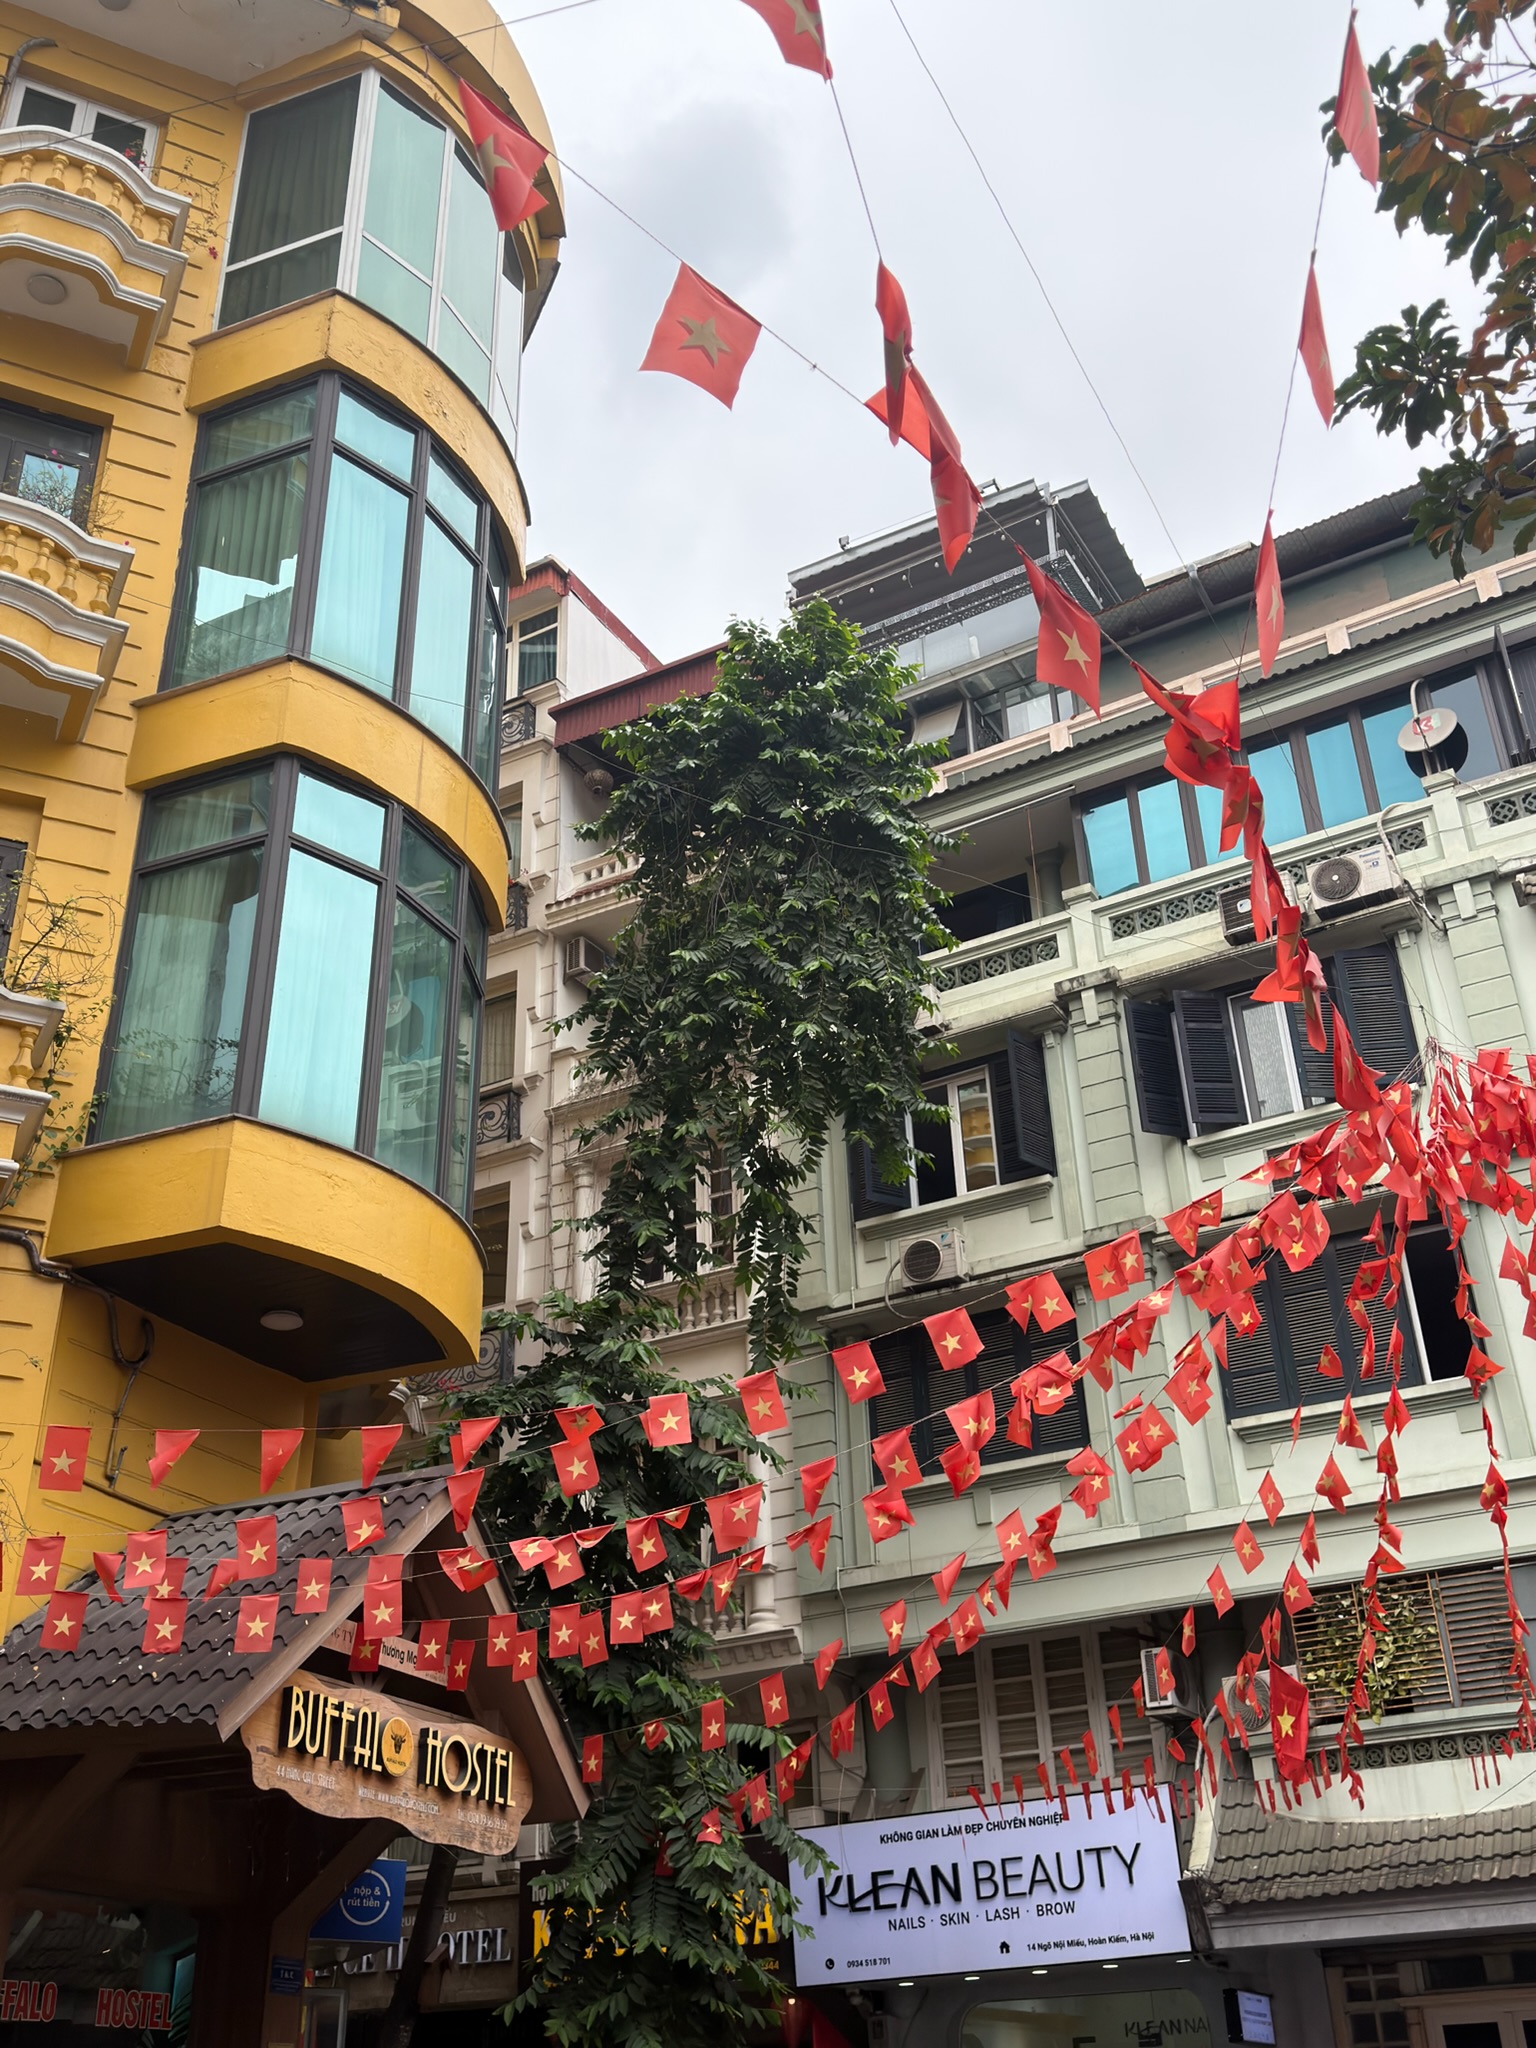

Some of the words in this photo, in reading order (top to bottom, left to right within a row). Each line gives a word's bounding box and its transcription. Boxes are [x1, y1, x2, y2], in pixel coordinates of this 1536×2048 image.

[380, 1641, 405, 1664] hương
[425, 1726, 516, 1807] HOSTEL
[880, 1830, 914, 1844] KHÔNG
[915, 1827, 939, 1840] GIAN
[941, 1824, 963, 1837] LÀM
[964, 1823, 984, 1836] ĐẸP
[986, 1814, 1027, 1832] CHUYÊN
[353, 1885, 372, 1897] nộp
[373, 1886, 381, 1896] &
[817, 1861, 962, 1916] KLEAN
[972, 1842, 1142, 1901] BEAUTY
[888, 1916, 926, 1931] NAILS
[939, 1912, 970, 1926] SKIN
[985, 1907, 1020, 1922] LASH
[1036, 1901, 1076, 1917] BROW
[437, 1926, 512, 1966] OTEL
[1027, 1943, 1036, 1951] 14
[1037, 1941, 1052, 1953] Ngõ
[1053, 1939, 1066, 1951] Nội
[1087, 1935, 1107, 1947] Hoàn
[1130, 1931, 1141, 1942] Hà
[1142, 1930, 1155, 1943] Nội
[846, 1959, 864, 1968] 0934
[865, 1958, 878, 1967] 518
[878, 1957, 891, 1965] 701
[95, 1987, 174, 2031] HOSTEL
